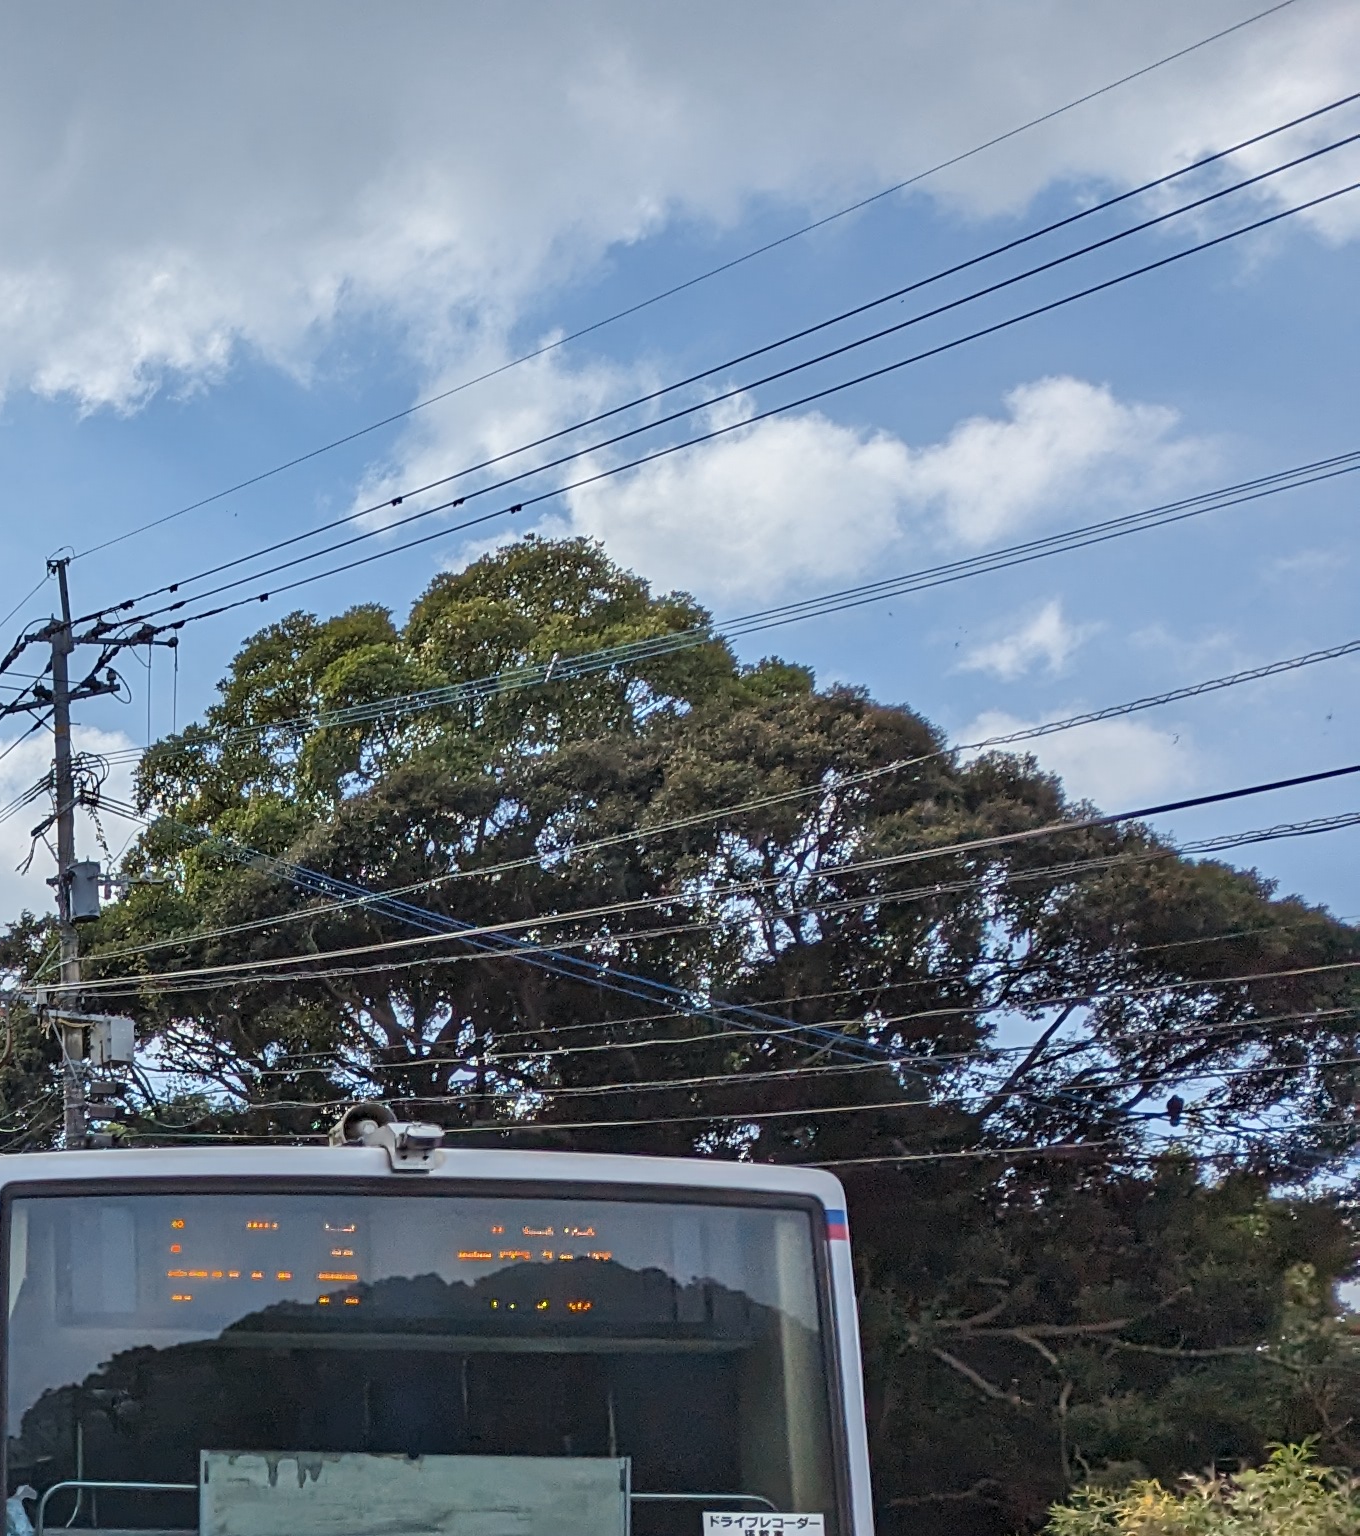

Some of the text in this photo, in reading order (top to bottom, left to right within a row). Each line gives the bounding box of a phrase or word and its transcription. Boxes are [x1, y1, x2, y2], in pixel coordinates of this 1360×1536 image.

[709, 1515, 821, 1530] ドライブレコーダー
